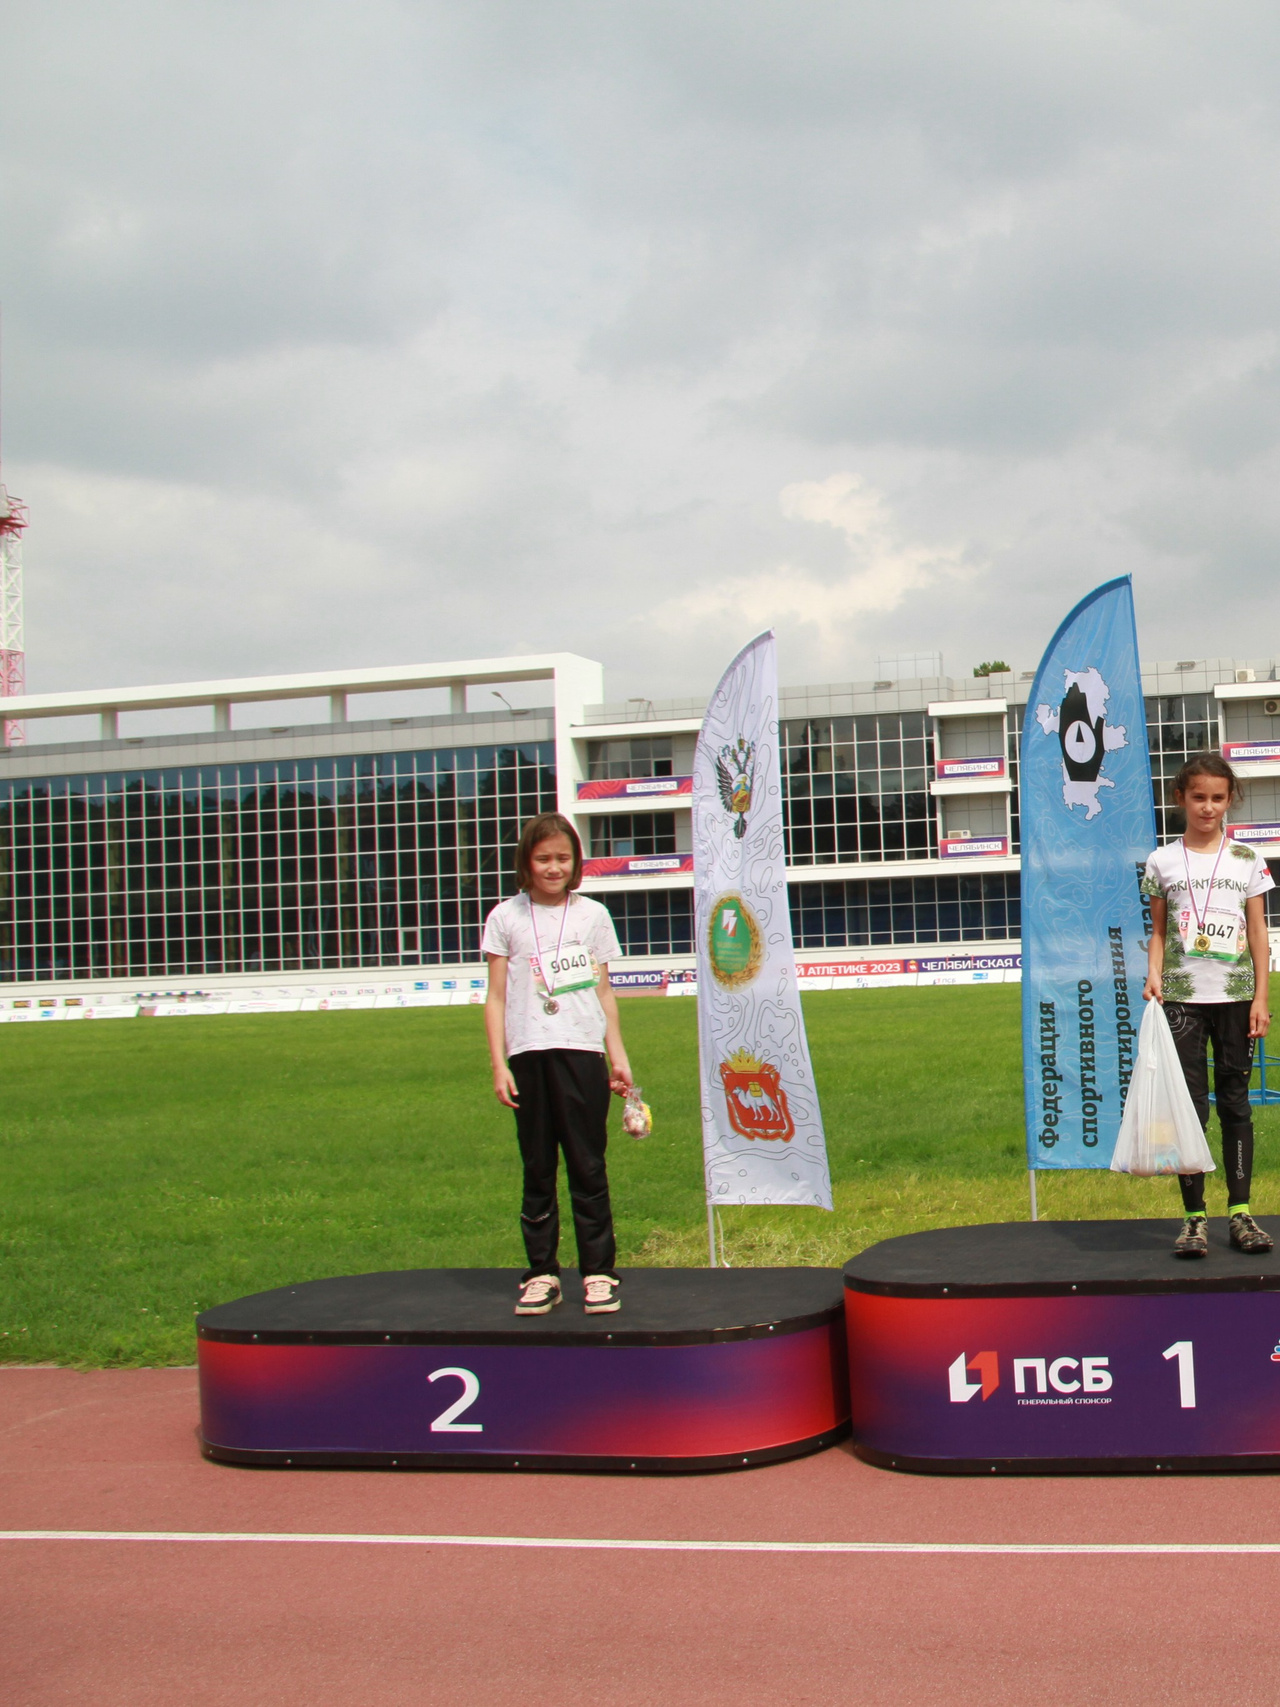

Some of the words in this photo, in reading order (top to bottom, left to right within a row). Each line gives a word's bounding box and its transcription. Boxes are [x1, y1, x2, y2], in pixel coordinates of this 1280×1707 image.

[945, 763, 997, 772] ЧЕЛЯБИНСК
[948, 842, 1000, 852] ЧЕЛЯБИНСК
[1197, 923, 1235, 939] 9047
[550, 954, 587, 973] 9040
[807, 964, 868, 976] АТЛЕТИКЕ
[870, 962, 901, 973] 2023
[922, 958, 1008, 971] ЧЕЛЯБИНСКАЯ
[1078, 979, 1102, 1148] спортивного
[1039, 1001, 1062, 1148] Федерация
[1013, 1356, 1113, 1393] ПСБ
[1162, 1341, 1196, 1408] 1
[427, 1367, 483, 1431] 2
[1017, 1397, 1073, 1406] ГЕНЕРАЛЬНЫЙ
[1074, 1397, 1112, 1405] СПОНСОР
